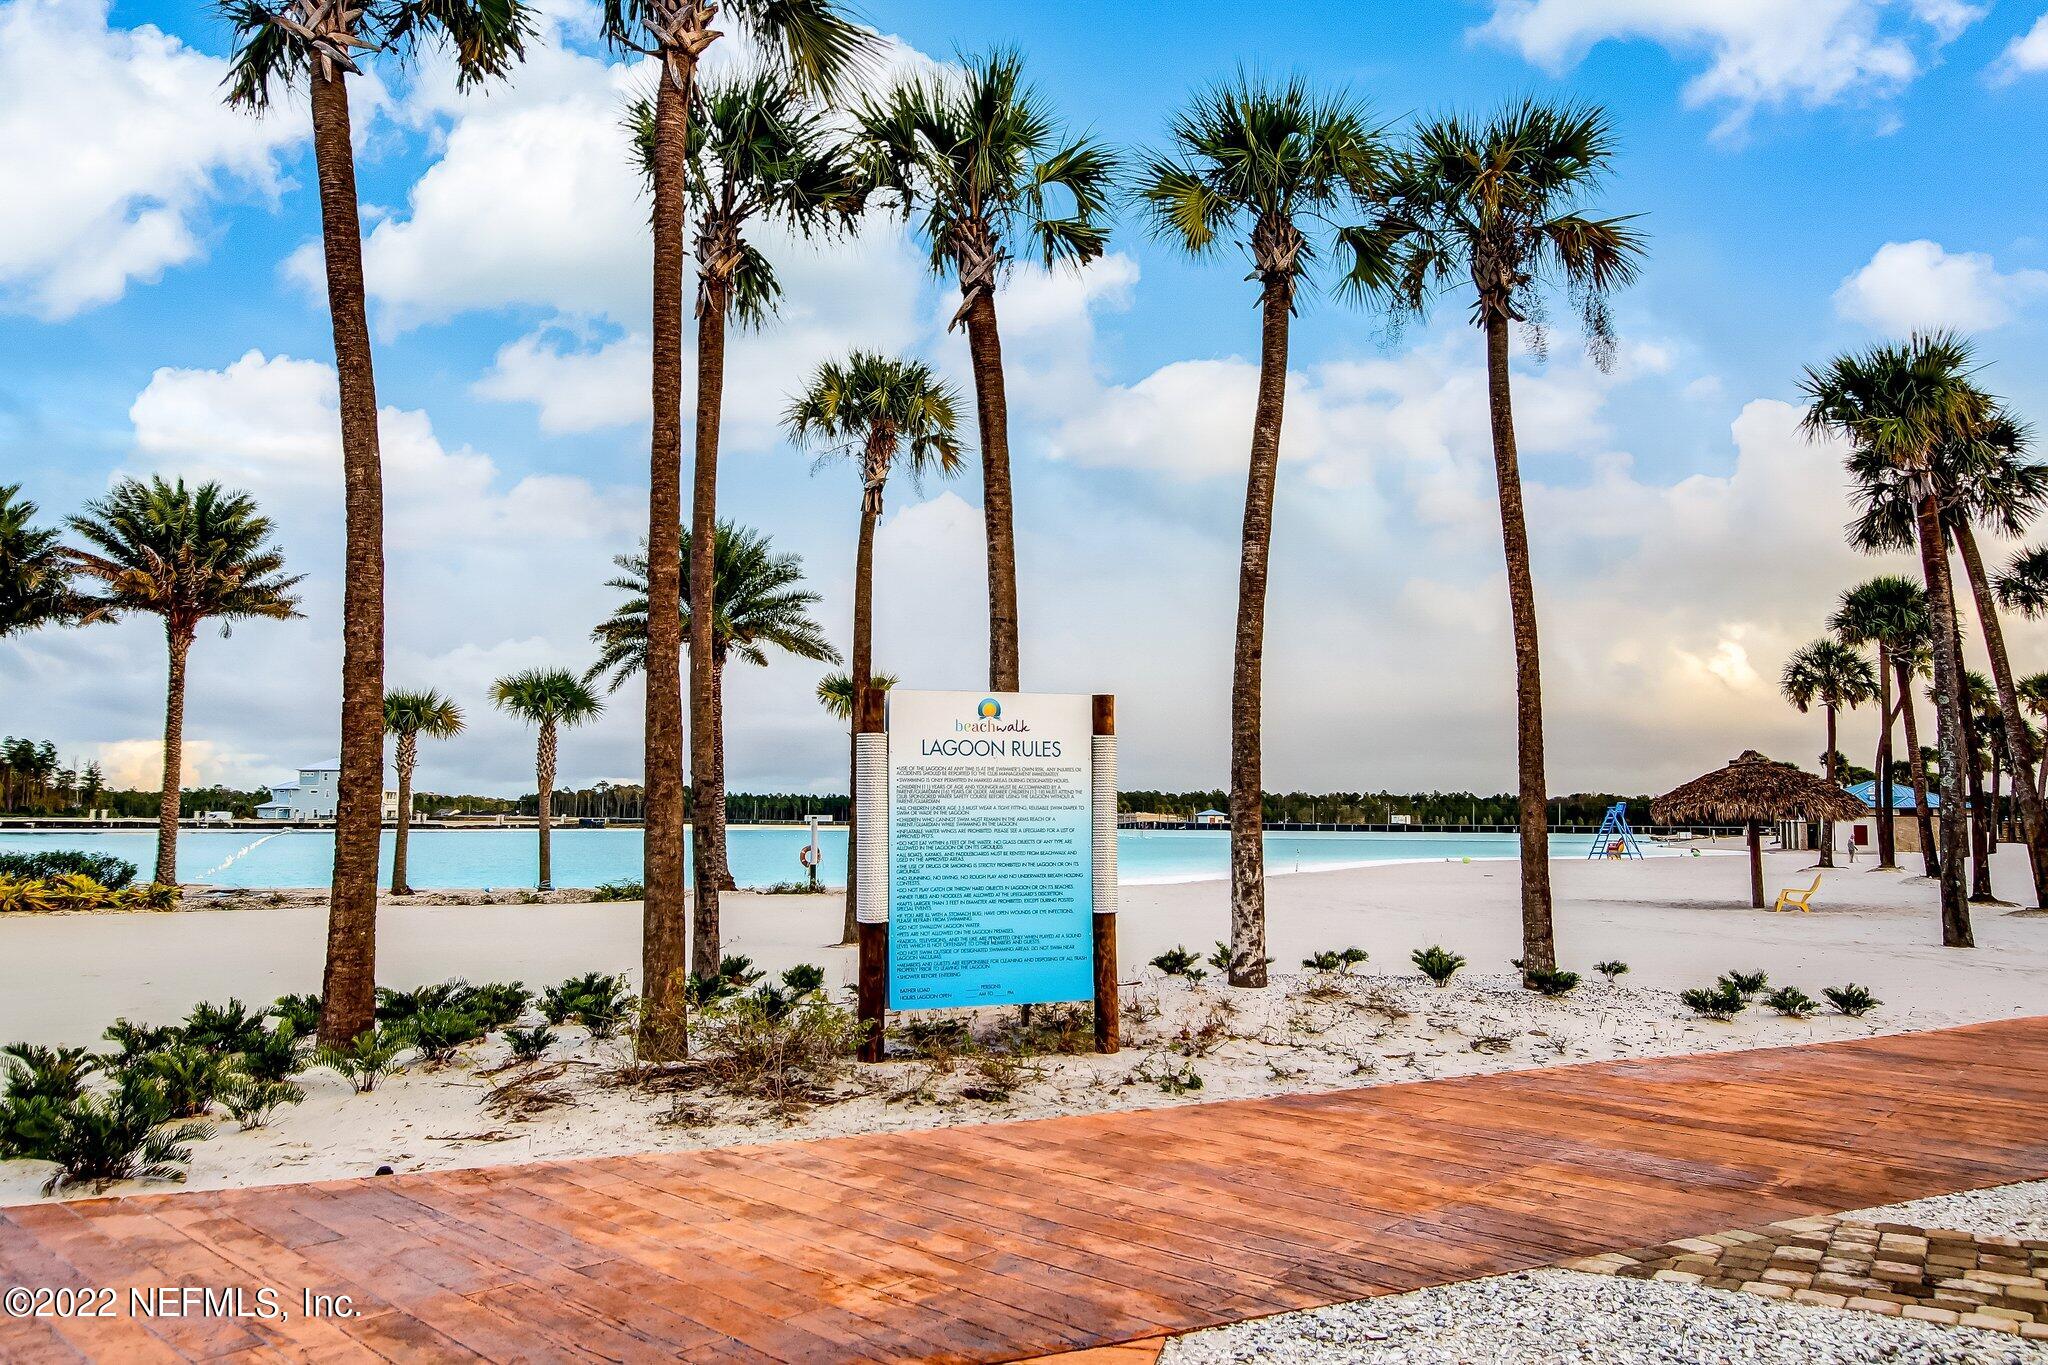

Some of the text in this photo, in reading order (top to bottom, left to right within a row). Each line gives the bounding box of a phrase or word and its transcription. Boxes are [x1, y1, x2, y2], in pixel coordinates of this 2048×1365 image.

[955, 718, 1031, 733] beachwalk
[922, 739, 1061, 757] LAGOON RULES
